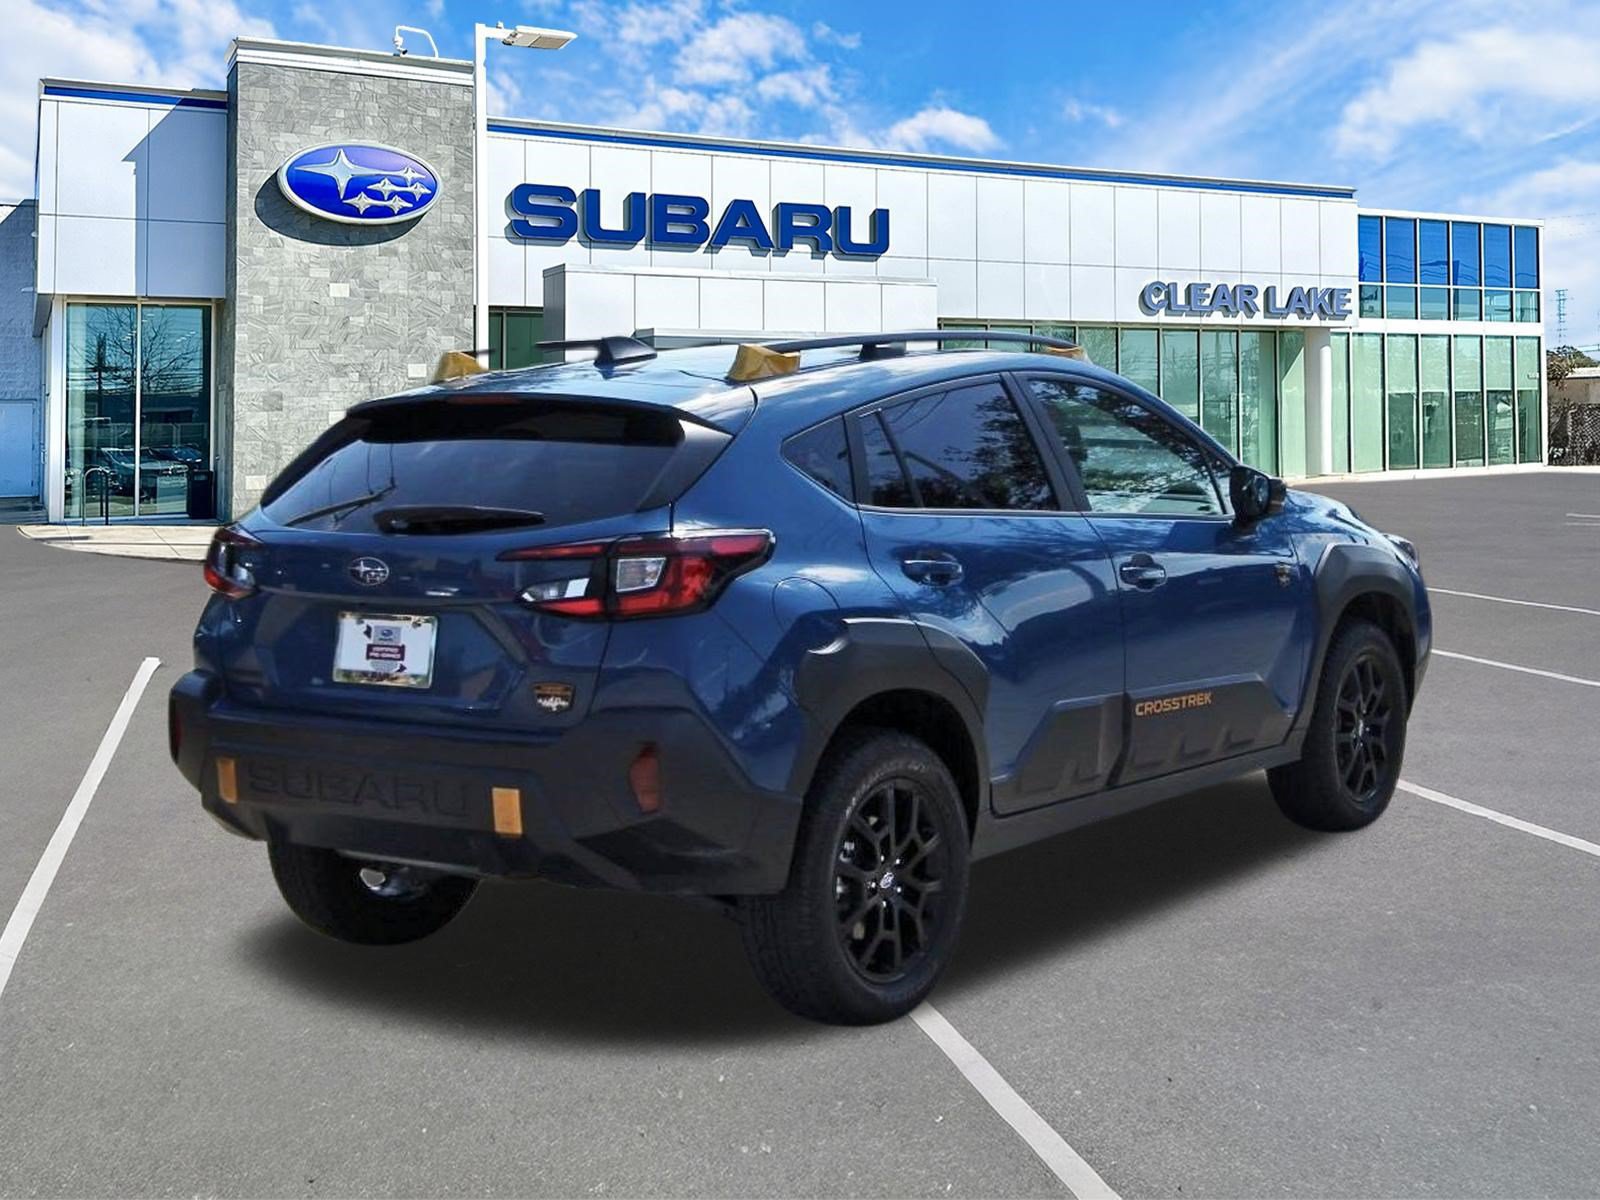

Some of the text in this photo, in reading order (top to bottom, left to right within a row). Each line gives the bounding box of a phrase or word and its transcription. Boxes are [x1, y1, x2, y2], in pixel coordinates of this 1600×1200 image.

[506, 183, 890, 260] SUBARU
[1141, 281, 1353, 319] CLEAR LAKE
[1135, 692, 1213, 716] CROSSTREK
[248, 761, 469, 817] SUBARU
